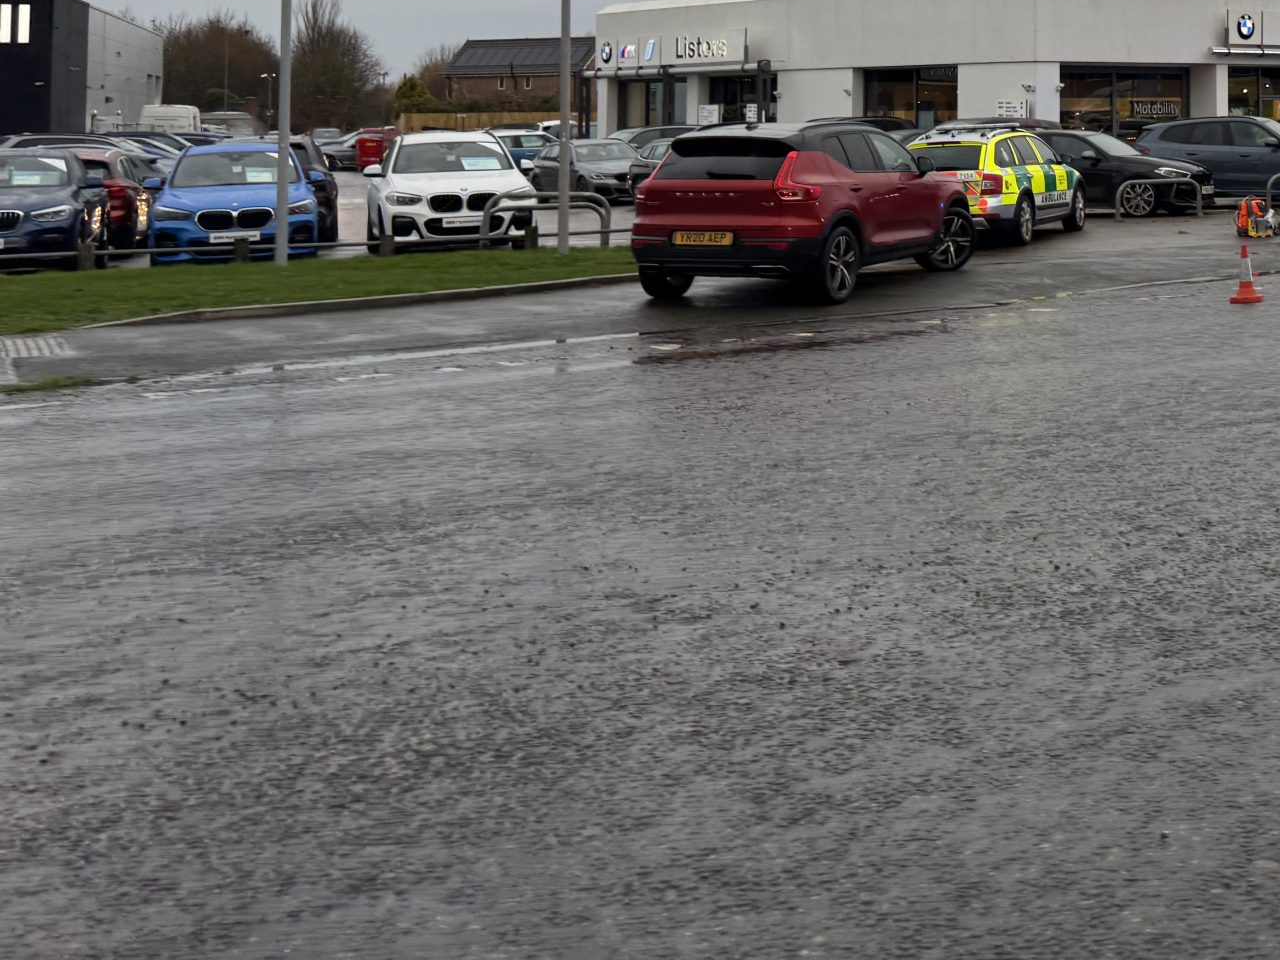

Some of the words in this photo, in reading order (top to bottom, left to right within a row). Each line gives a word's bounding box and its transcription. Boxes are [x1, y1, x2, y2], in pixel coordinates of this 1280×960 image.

[675, 36, 728, 59] Listers
[1133, 101, 1178, 117] Motability
[1041, 191, 1067, 204] AMBULANCE
[680, 232, 705, 243] YR20
[707, 232, 727, 244] AEP
